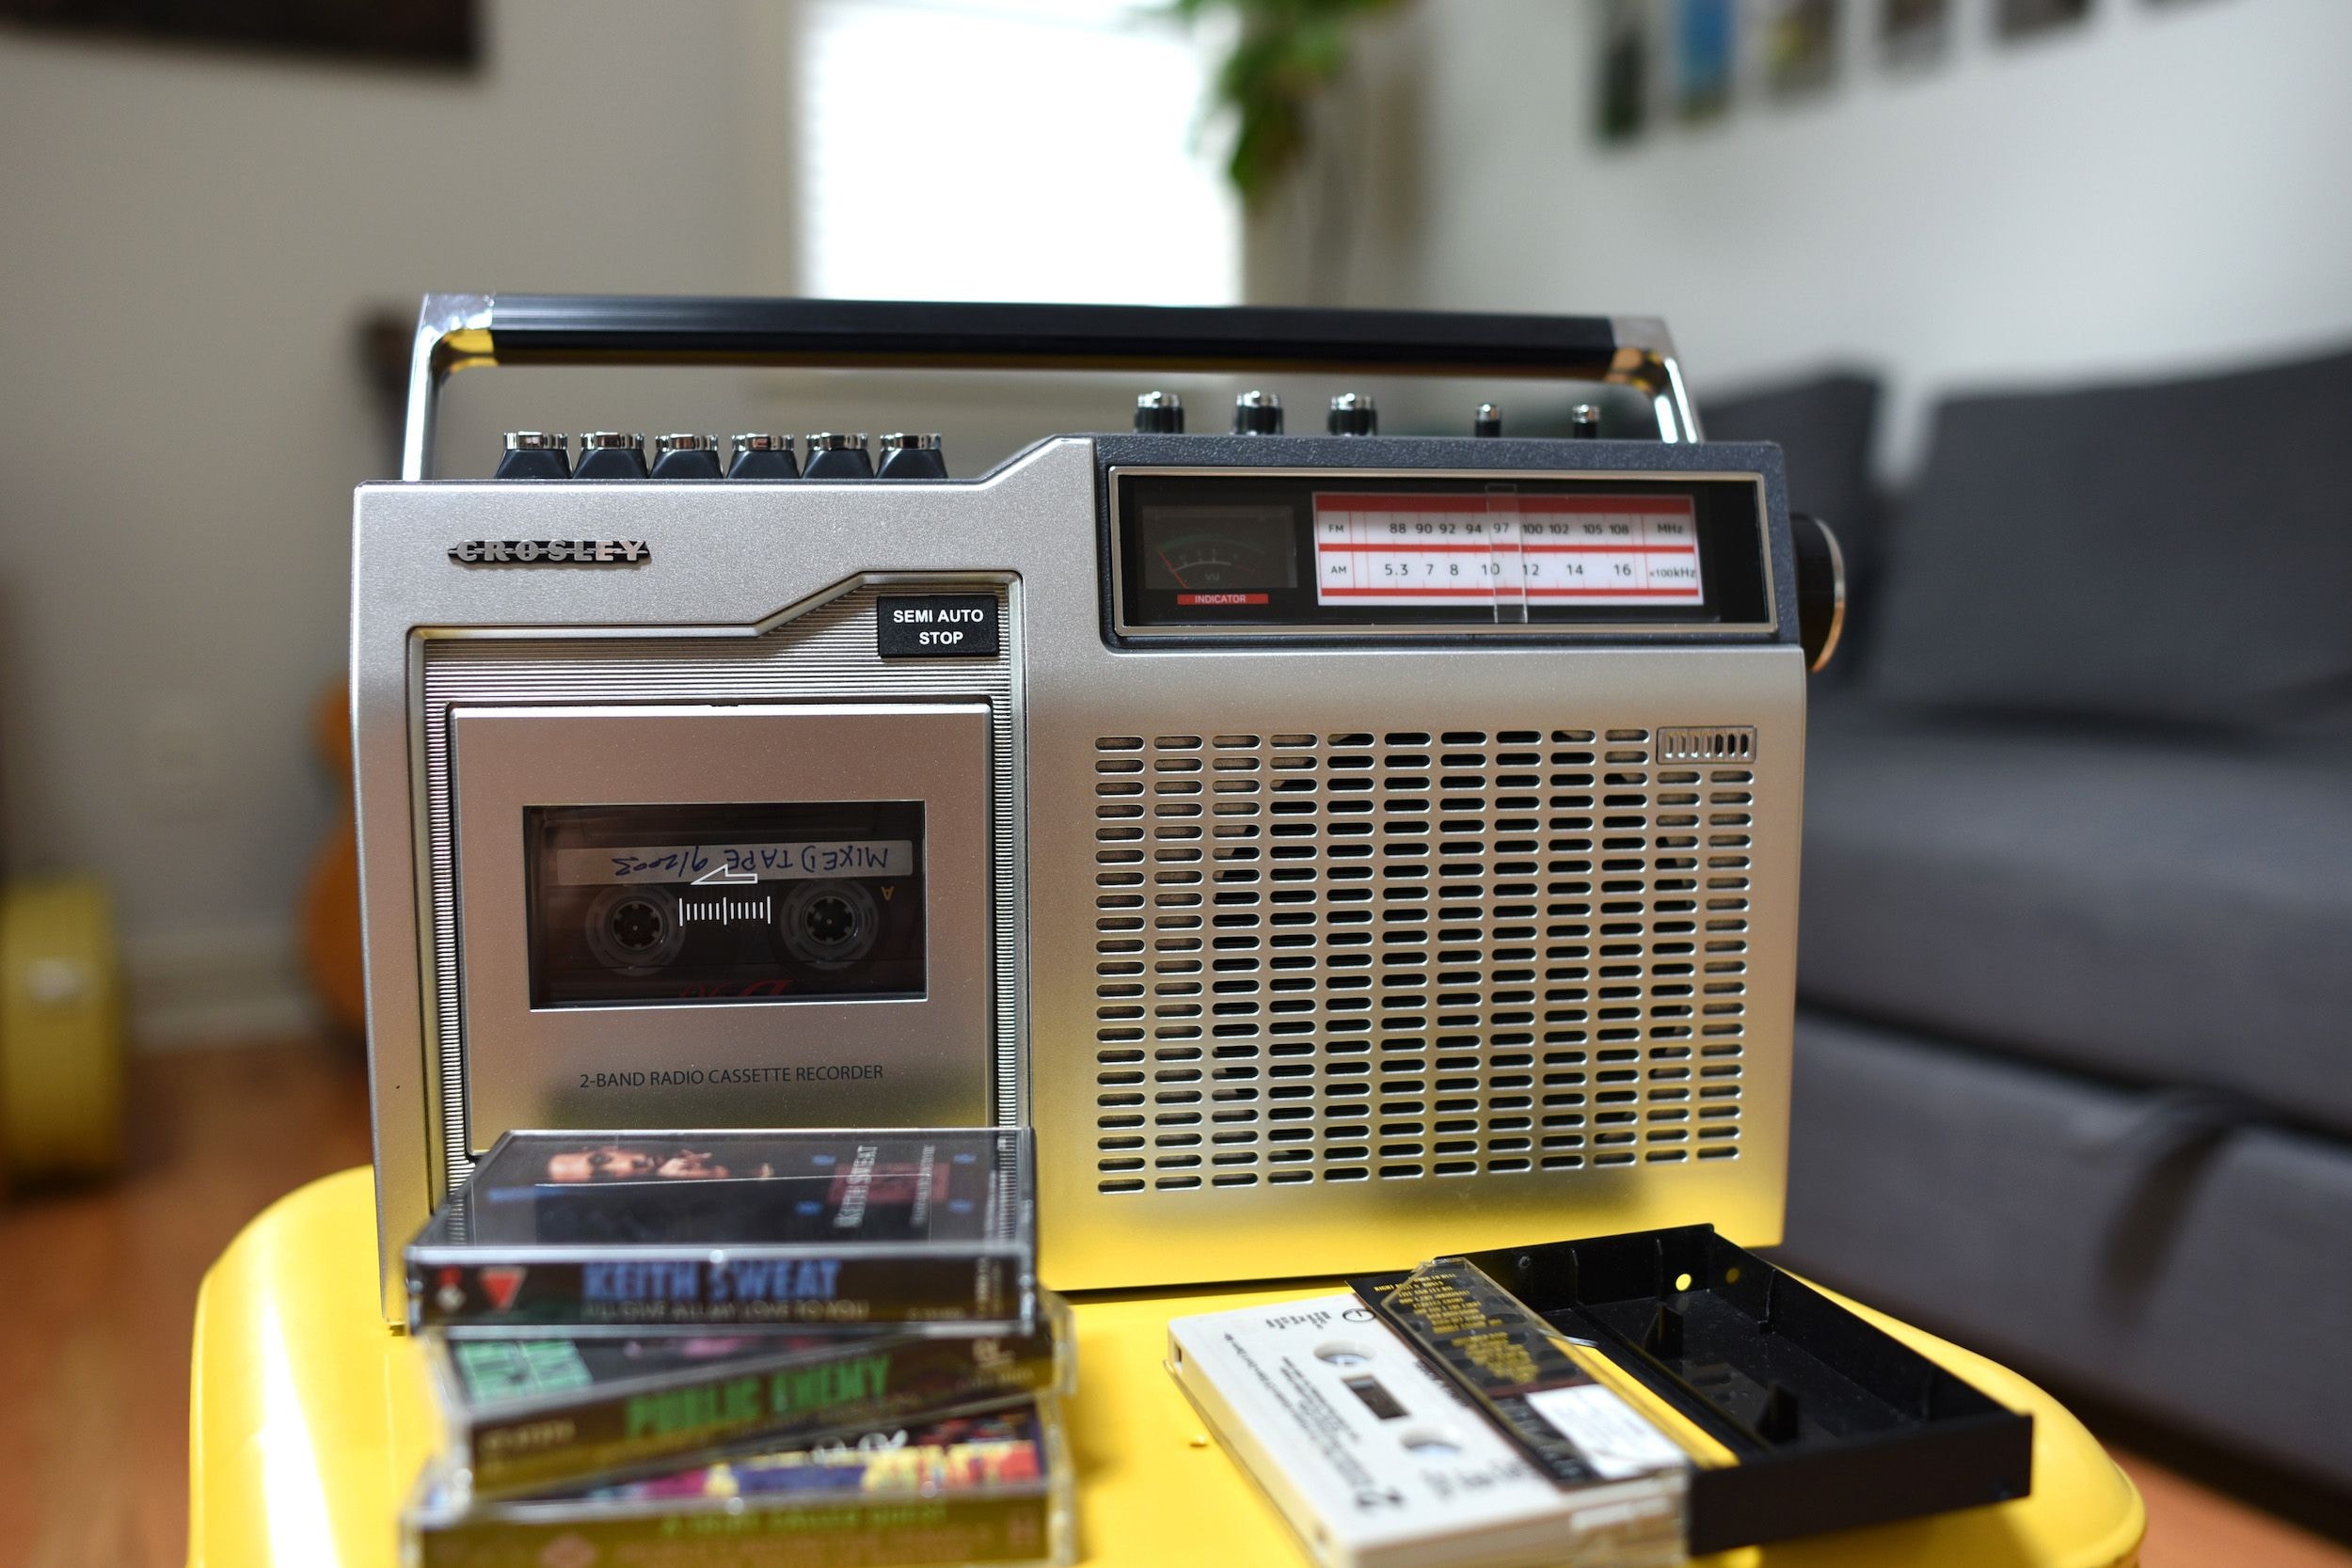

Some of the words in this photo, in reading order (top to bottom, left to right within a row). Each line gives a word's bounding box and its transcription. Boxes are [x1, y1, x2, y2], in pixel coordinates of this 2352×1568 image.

[1327, 523, 1344, 532] FM
[1389, 523, 1406, 534] 88
[1415, 523, 1433, 534] 90
[1438, 523, 1456, 534] 92
[1465, 523, 1482, 534] 94
[1492, 522, 1510, 533] 97
[1522, 523, 1543, 534] 100
[1549, 523, 1569, 534] 102
[1582, 523, 1603, 534] 105
[1610, 523, 1629, 535] 108
[1657, 523, 1684, 534] MHz
[453, 539, 646, 562] CROSLEY
[1329, 565, 1347, 574] AM
[1384, 563, 1409, 576] 5.3
[1426, 564, 1434, 576] 7
[1449, 564, 1459, 576] 8
[1481, 563, 1501, 576] 10
[1522, 563, 1540, 576] 12
[1565, 564, 1584, 575] 14
[1613, 563, 1631, 577] 16
[1194, 594, 1247, 604] INDICATOR
[893, 610, 933, 623] SEMI
[937, 609, 984, 623] AUTO
[918, 630, 963, 645] STOP
[723, 848, 794, 871] TAPE
[801, 845, 888, 873] MIXED
[881, 886, 895, 901] A
[580, 1071, 646, 1088] 2-BAND
[650, 1069, 705, 1086] RADIO
[707, 1068, 791, 1084] CASSETTE
[796, 1065, 883, 1082] RECORDER
[581, 1260, 700, 1302] KEITH
[706, 1260, 843, 1302] SWEAT
